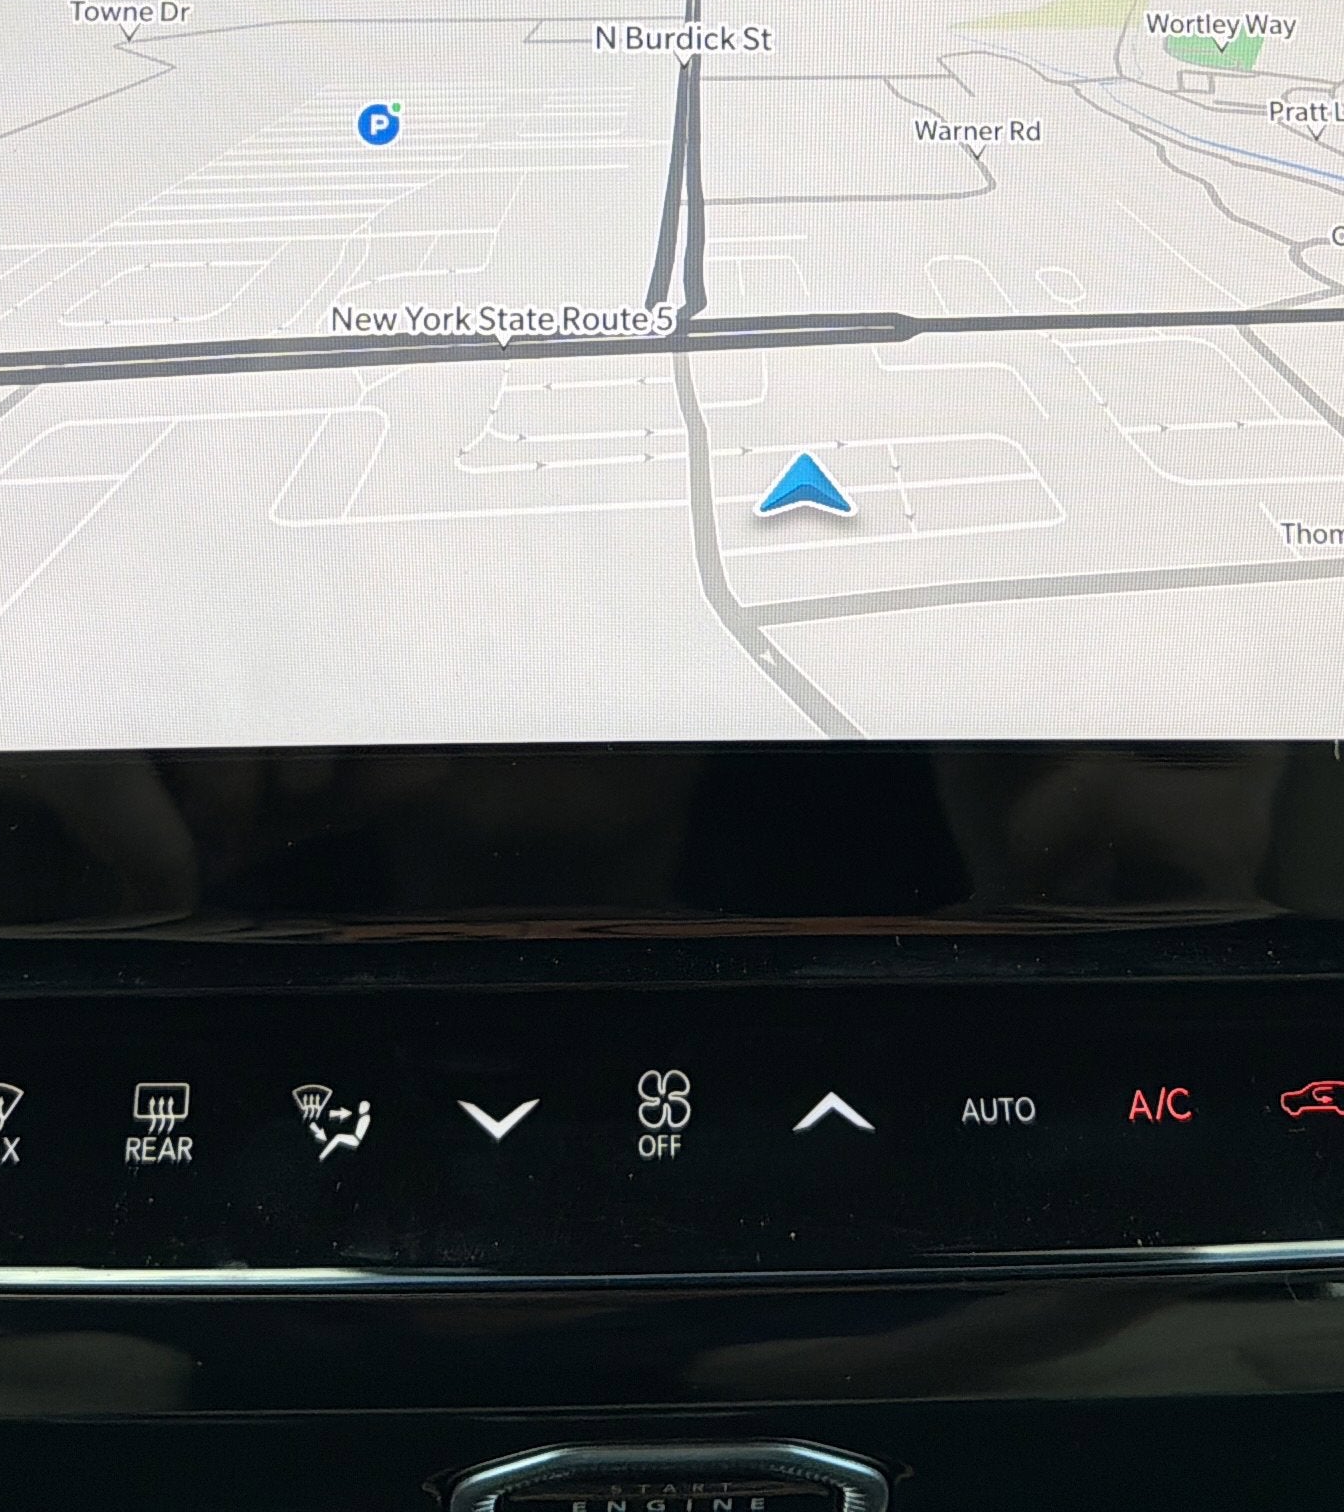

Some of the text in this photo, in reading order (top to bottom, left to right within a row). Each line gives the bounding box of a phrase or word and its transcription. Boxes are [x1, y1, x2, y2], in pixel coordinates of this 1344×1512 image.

[70, 0, 190, 23] Towne Dr
[596, 25, 773, 51] N Burdick St
[1146, 12, 1297, 41] Wortley Way
[1269, 101, 1327, 123] Pratt
[915, 118, 1041, 142] Warner Rd
[332, 305, 673, 332] New York State Route 5
[961, 1098, 1037, 1122] AUTO
[1129, 1089, 1191, 1121] A/C
[125, 1137, 193, 1162] REAR
[638, 1135, 681, 1158] OFF
[610, 1482, 732, 1495] START
[572, 1498, 765, 1512] ENGINE
